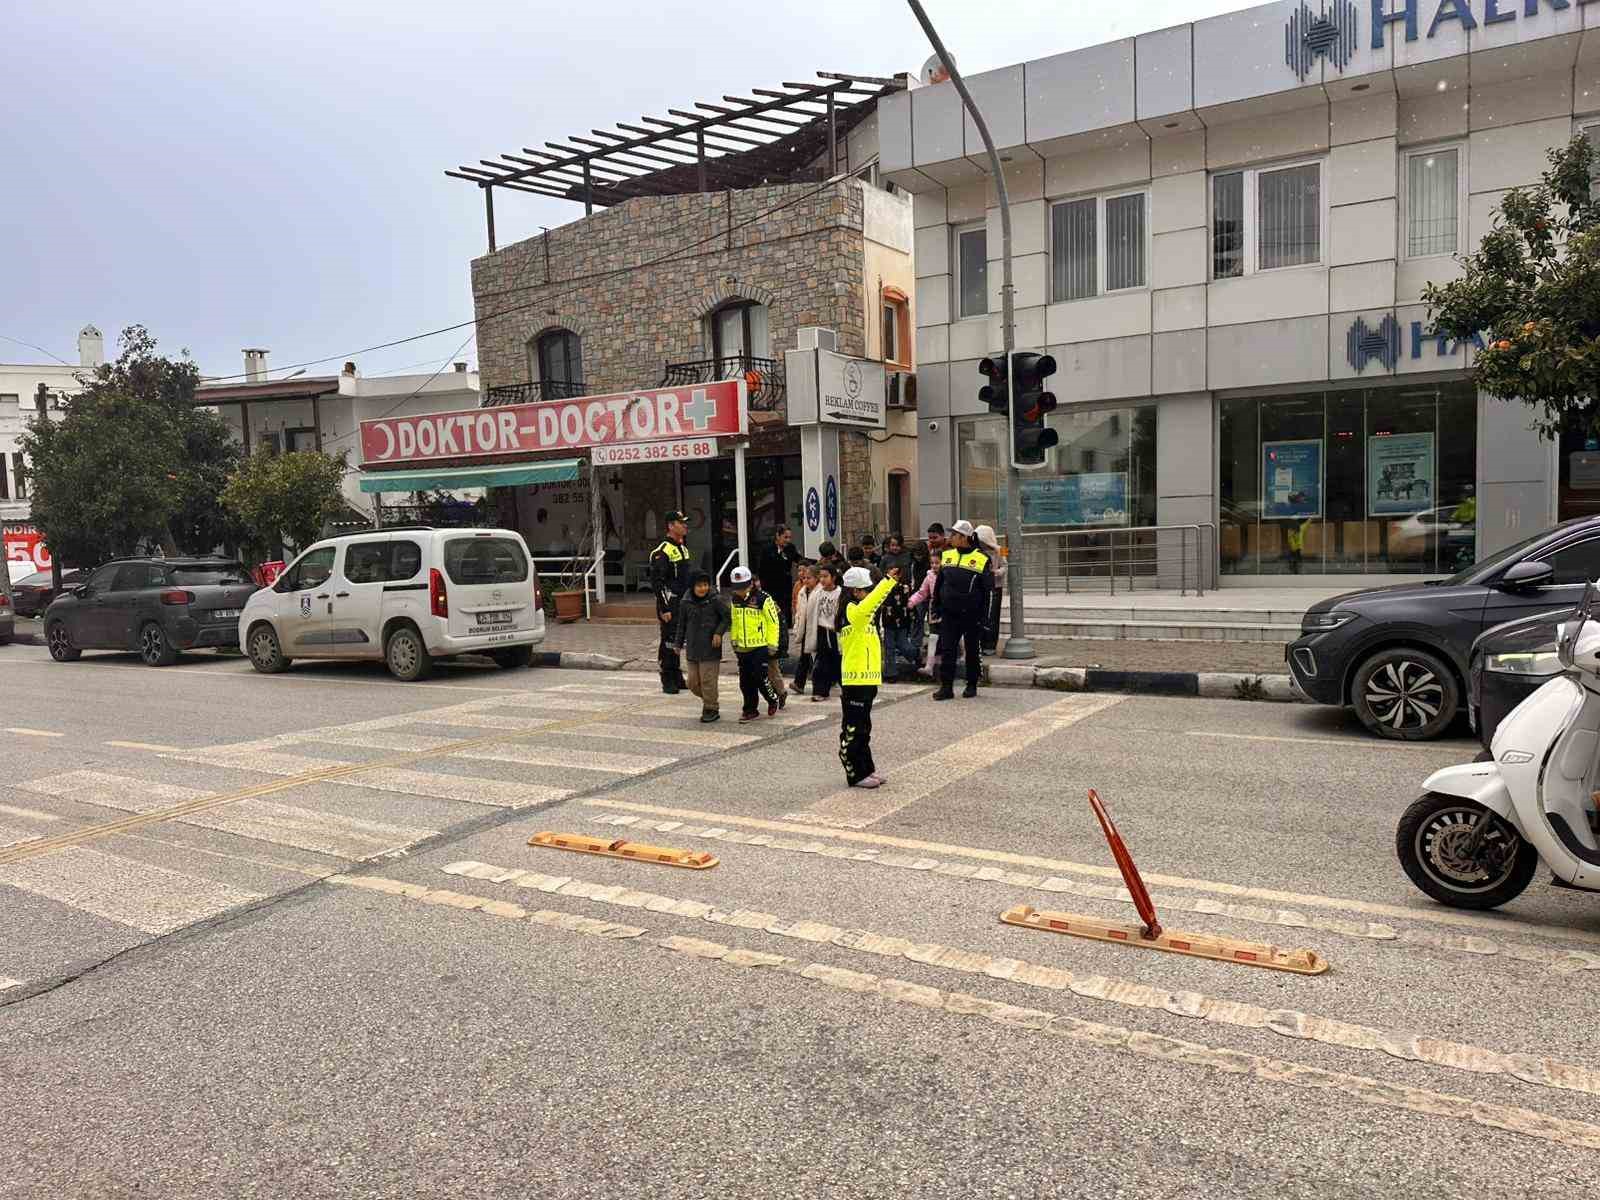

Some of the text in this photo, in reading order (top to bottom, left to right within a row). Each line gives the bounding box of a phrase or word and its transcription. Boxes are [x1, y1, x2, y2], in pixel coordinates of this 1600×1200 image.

[609, 442, 711, 461] 0252 382 55 88
